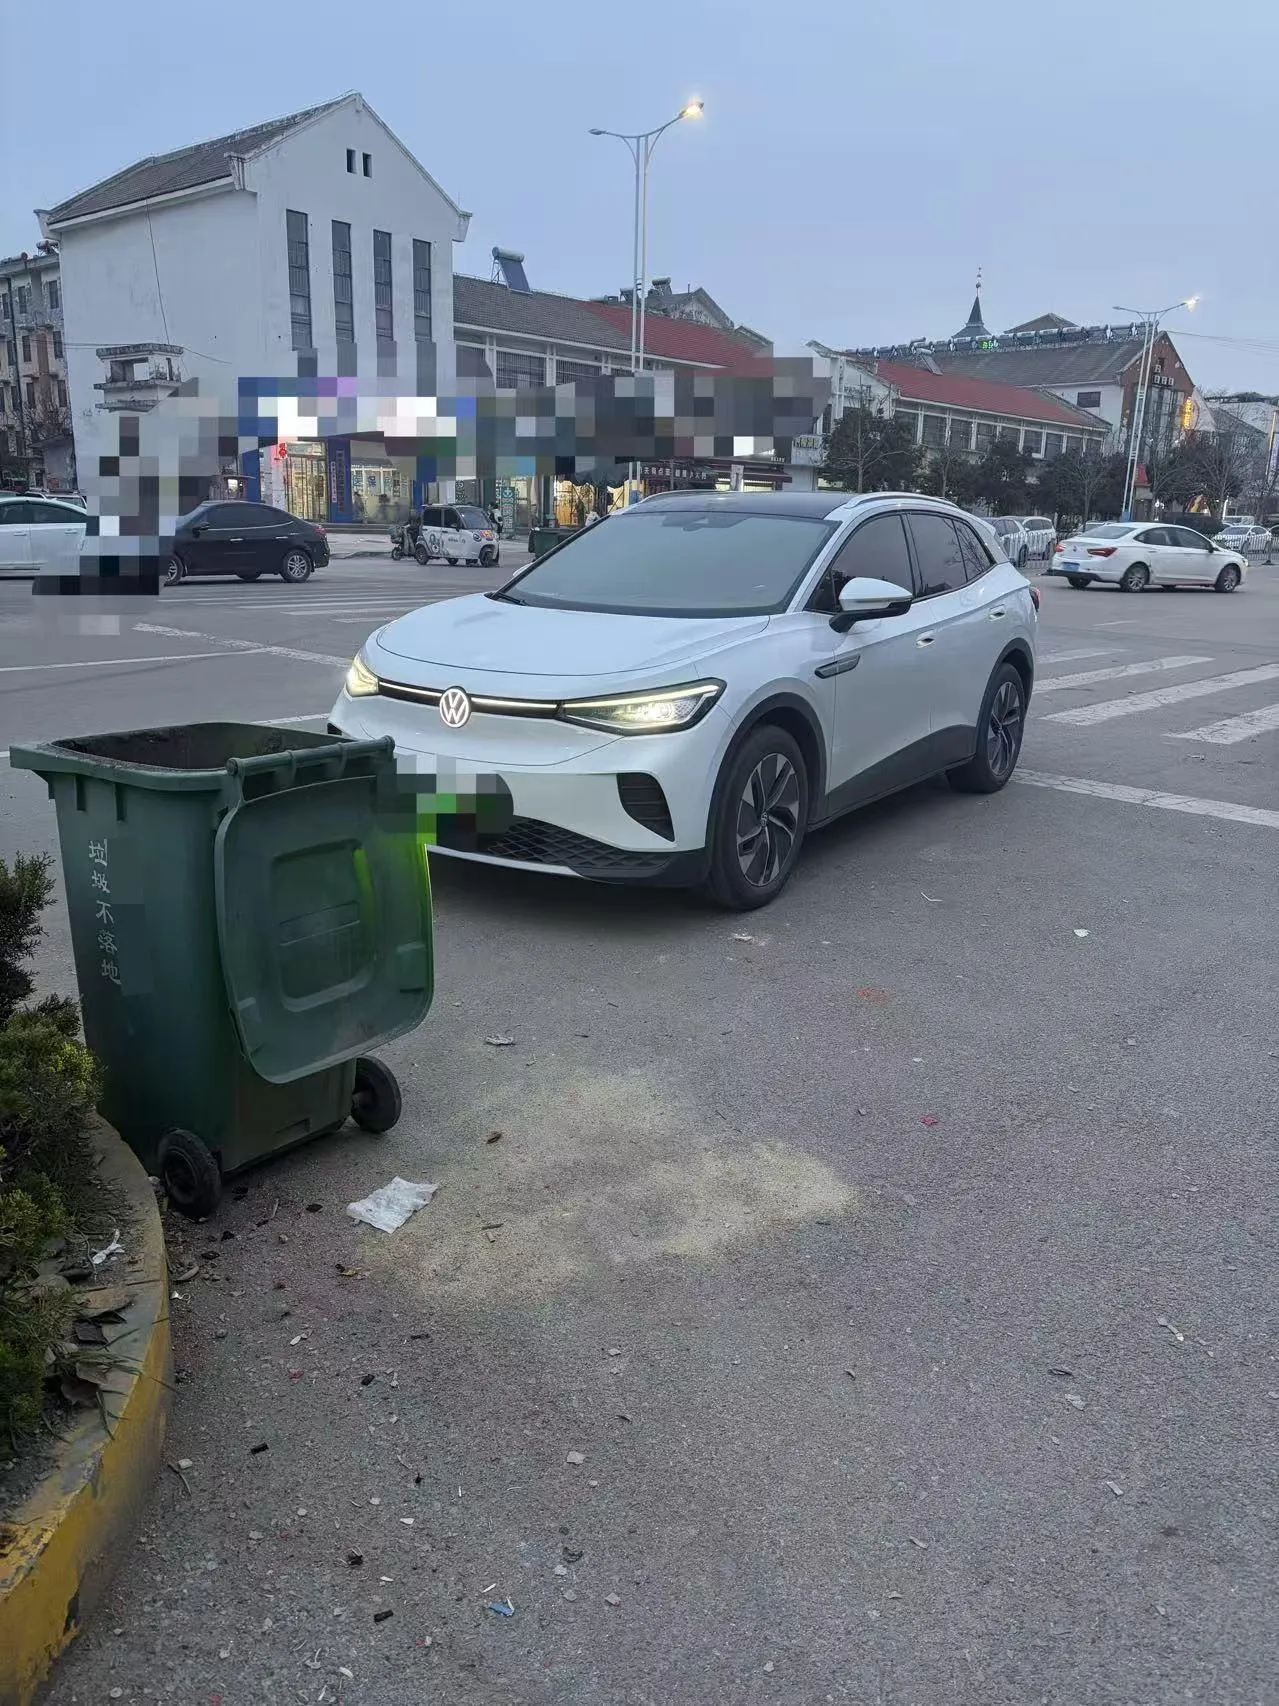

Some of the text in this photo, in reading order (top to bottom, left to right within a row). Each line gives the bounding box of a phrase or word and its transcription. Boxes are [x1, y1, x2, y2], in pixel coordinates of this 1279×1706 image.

[440, 688, 469, 727] VW
[88, 838, 122, 985] 垃圾不落地
